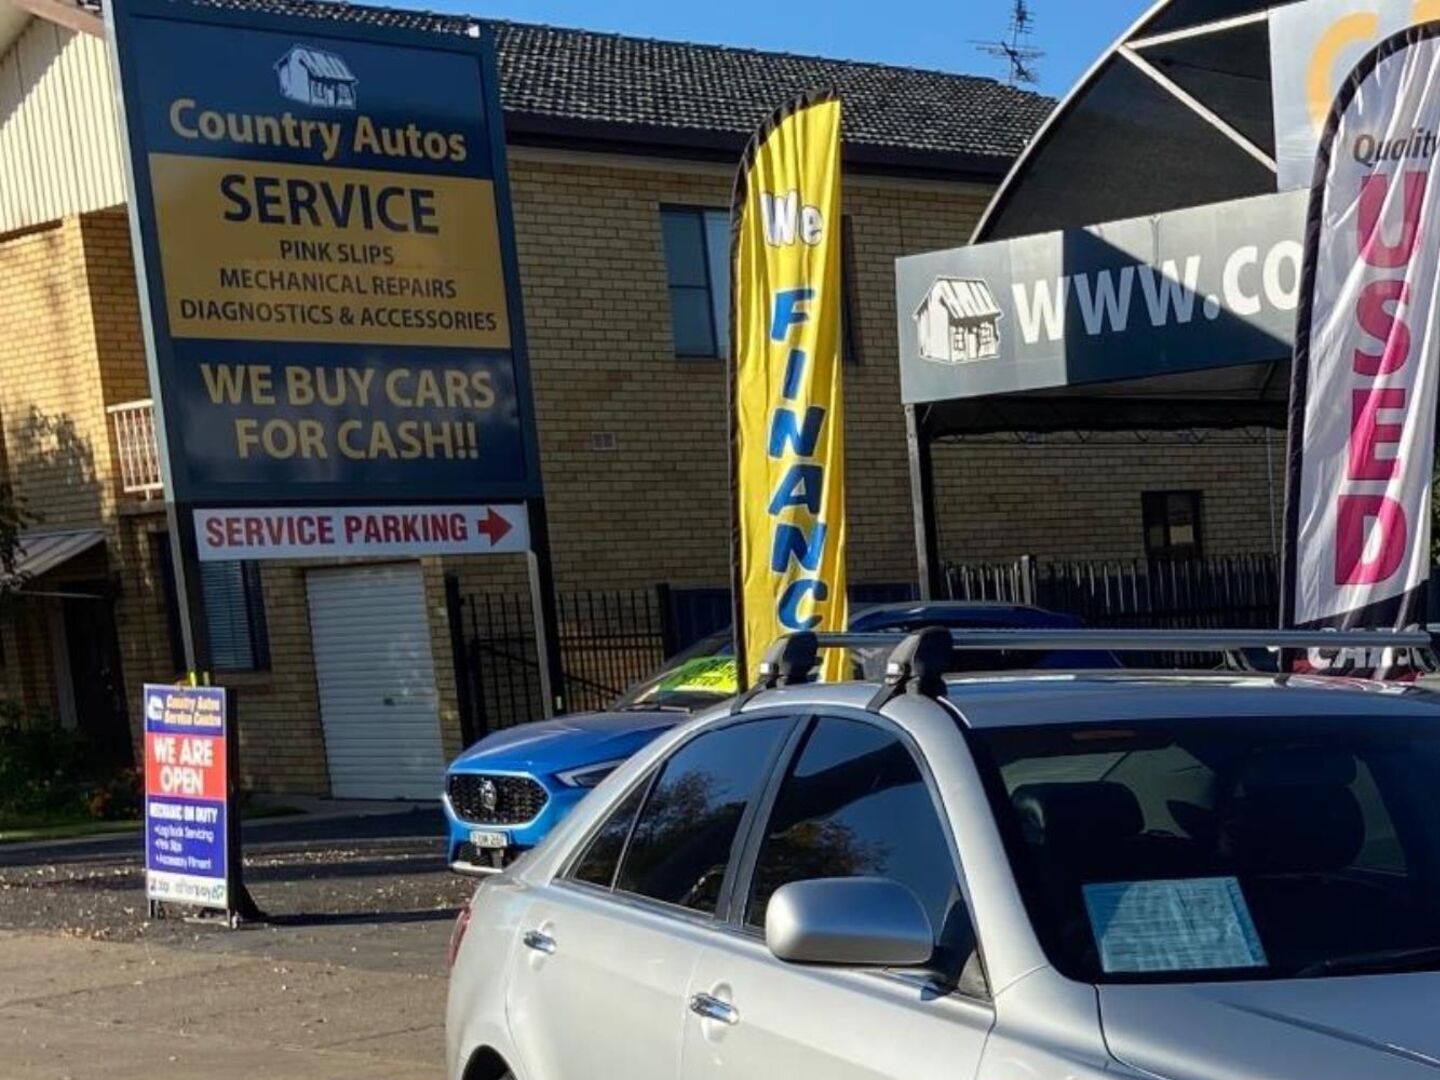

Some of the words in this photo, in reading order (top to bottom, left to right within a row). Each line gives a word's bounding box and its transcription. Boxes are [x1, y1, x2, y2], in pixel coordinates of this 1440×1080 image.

[169, 98, 340, 160] Country
[353, 115, 467, 161] Autos
[220, 173, 440, 235] SERVICE
[762, 191, 824, 247] We
[279, 239, 333, 263] PINK
[338, 244, 395, 266] SLIPS
[219, 267, 368, 296] MECHANICAL
[372, 275, 457, 299] REPAIRS
[180, 299, 334, 325] DIAGNOSTICS
[338, 309, 355, 326] &
[360, 306, 497, 332] ACCESSORIES
[201, 362, 276, 405] WE
[285, 364, 376, 407] BUY
[384, 368, 495, 409] CARS
[1335, 173, 1428, 585] USED
[235, 418, 329, 460] FOR
[337, 420, 479, 460] CASH!!
[767, 289, 829, 631] FINANC
[205, 515, 335, 548] SERVICE
[344, 512, 468, 544] PARKING
[154, 736, 176, 765] WE
[180, 738, 214, 767] ARE
[160, 766, 205, 795] OPEN
